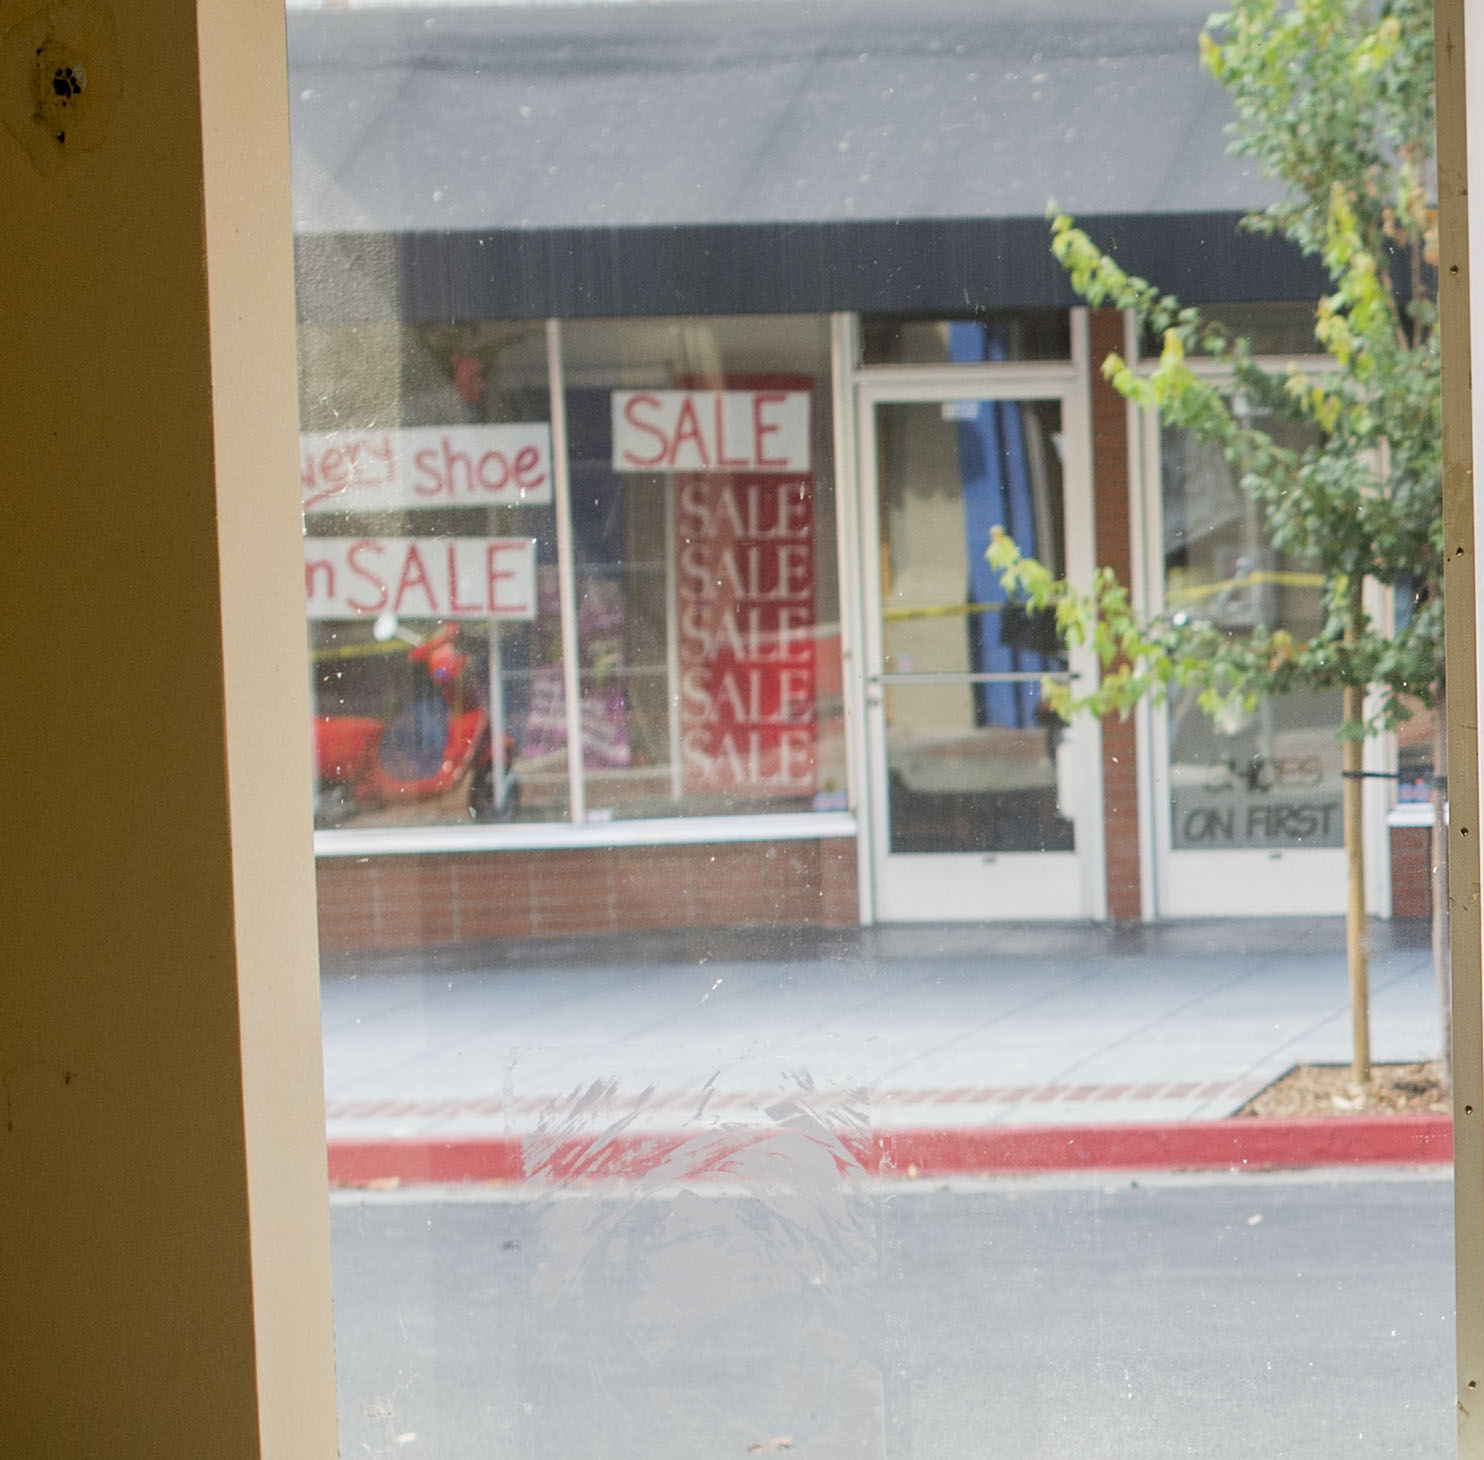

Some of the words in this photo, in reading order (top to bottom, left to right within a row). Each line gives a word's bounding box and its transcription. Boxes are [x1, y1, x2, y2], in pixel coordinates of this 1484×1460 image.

[623, 390, 792, 468] SALE
[413, 436, 547, 496] shoe
[681, 483, 811, 539] SALE
[305, 557, 335, 600] n
[345, 537, 528, 615] SALE
[681, 544, 811, 600] SALE
[681, 605, 811, 663] SALE
[681, 666, 811, 724] SALE
[681, 729, 811, 787] SALE
[1184, 802, 1235, 842] ON
[1245, 798, 1340, 839] FIRST
